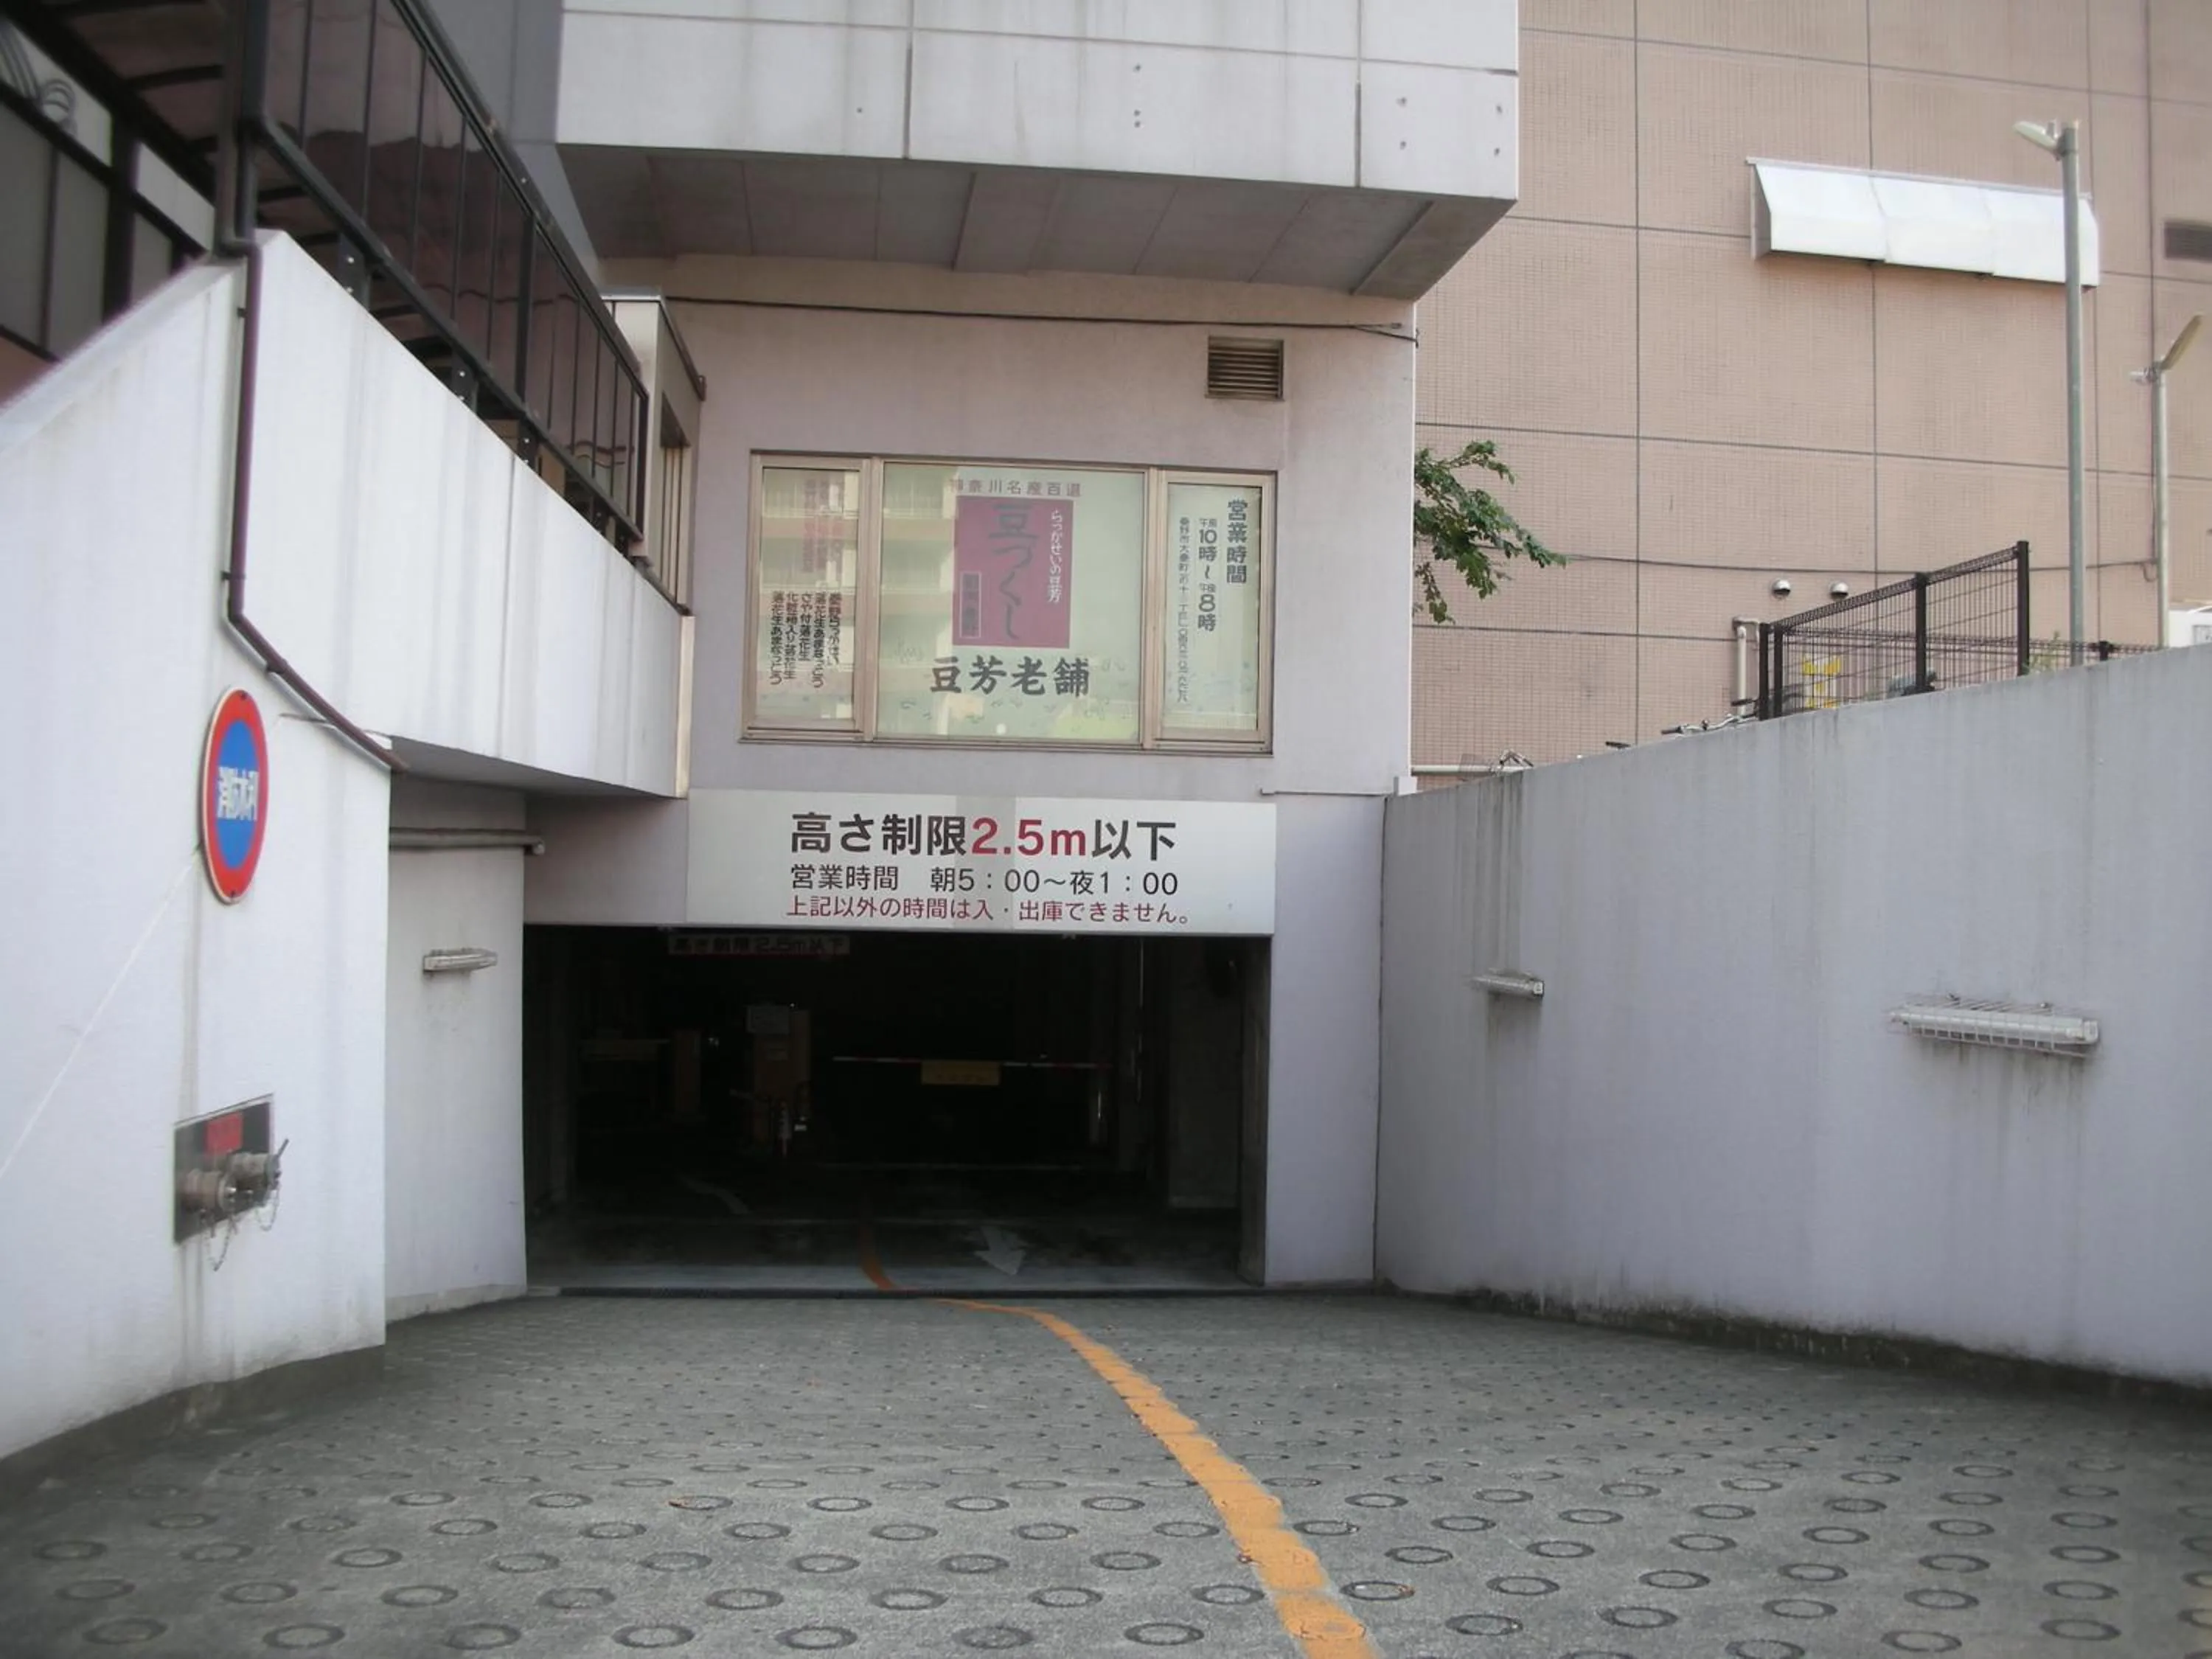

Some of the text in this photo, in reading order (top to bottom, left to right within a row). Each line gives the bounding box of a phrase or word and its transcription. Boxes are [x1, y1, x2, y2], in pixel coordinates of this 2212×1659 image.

[1227, 499, 1248, 583] 営業時間
[791, 812, 1176, 861] 高さ制限2.5m以下
[791, 863, 899, 891] 営業時間
[786, 894, 1189, 925] 上記以外の時間は入・出庫できません。
